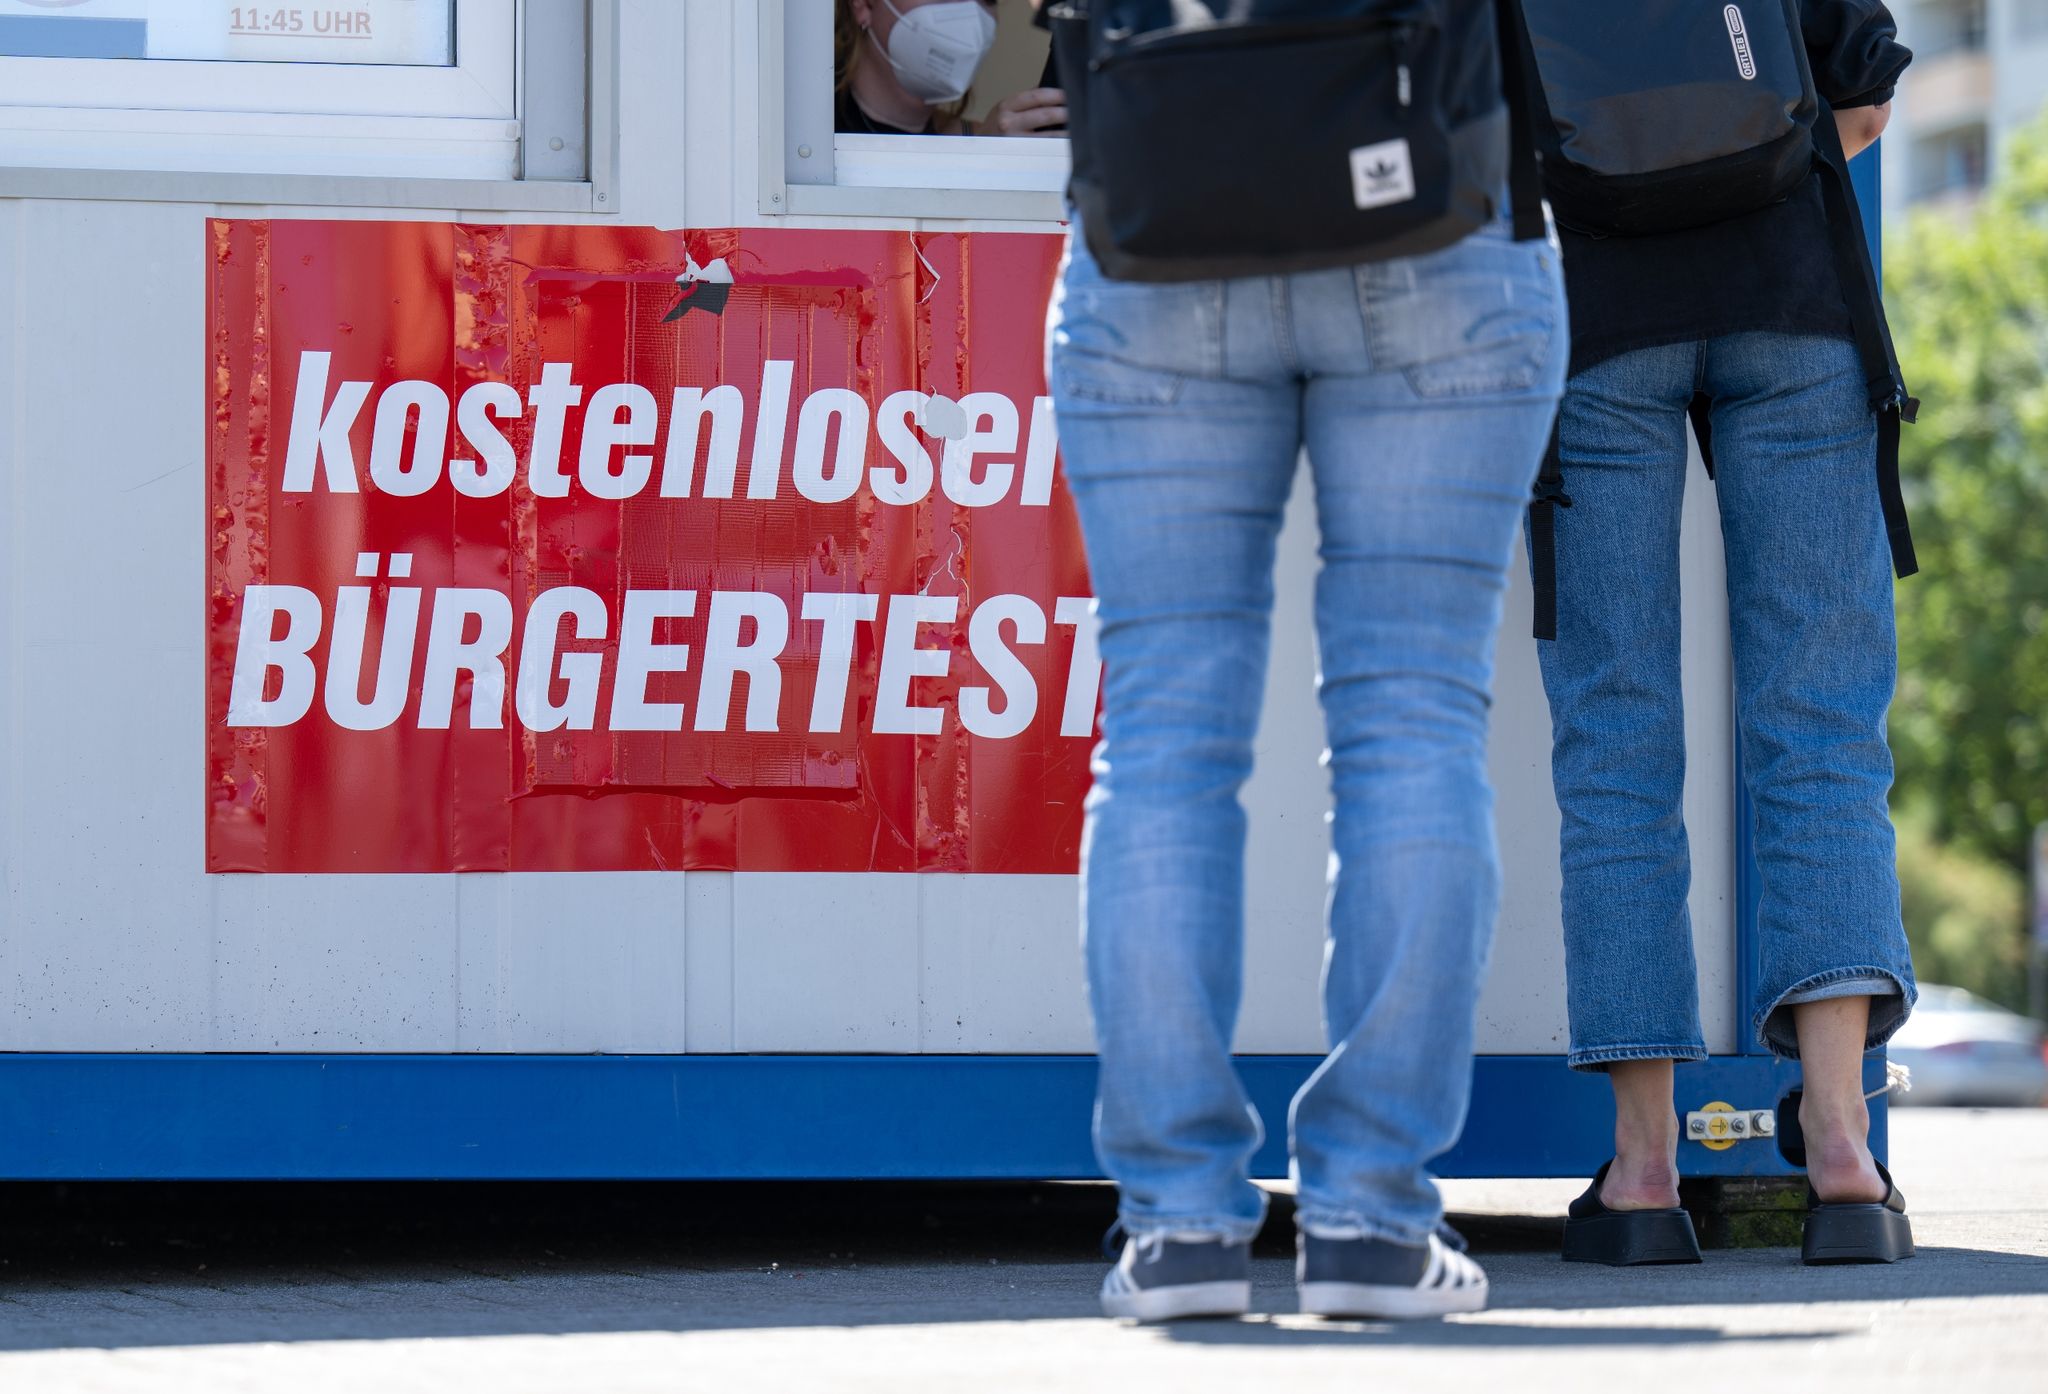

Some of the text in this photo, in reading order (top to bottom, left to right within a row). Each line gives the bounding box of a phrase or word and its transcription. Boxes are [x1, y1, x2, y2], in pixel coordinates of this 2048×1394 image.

[231, 8, 372, 34] 11:45 UHR
[1736, 37, 1752, 75] ORTLIEB
[227, 552, 1103, 739] BÜRGERTEST
